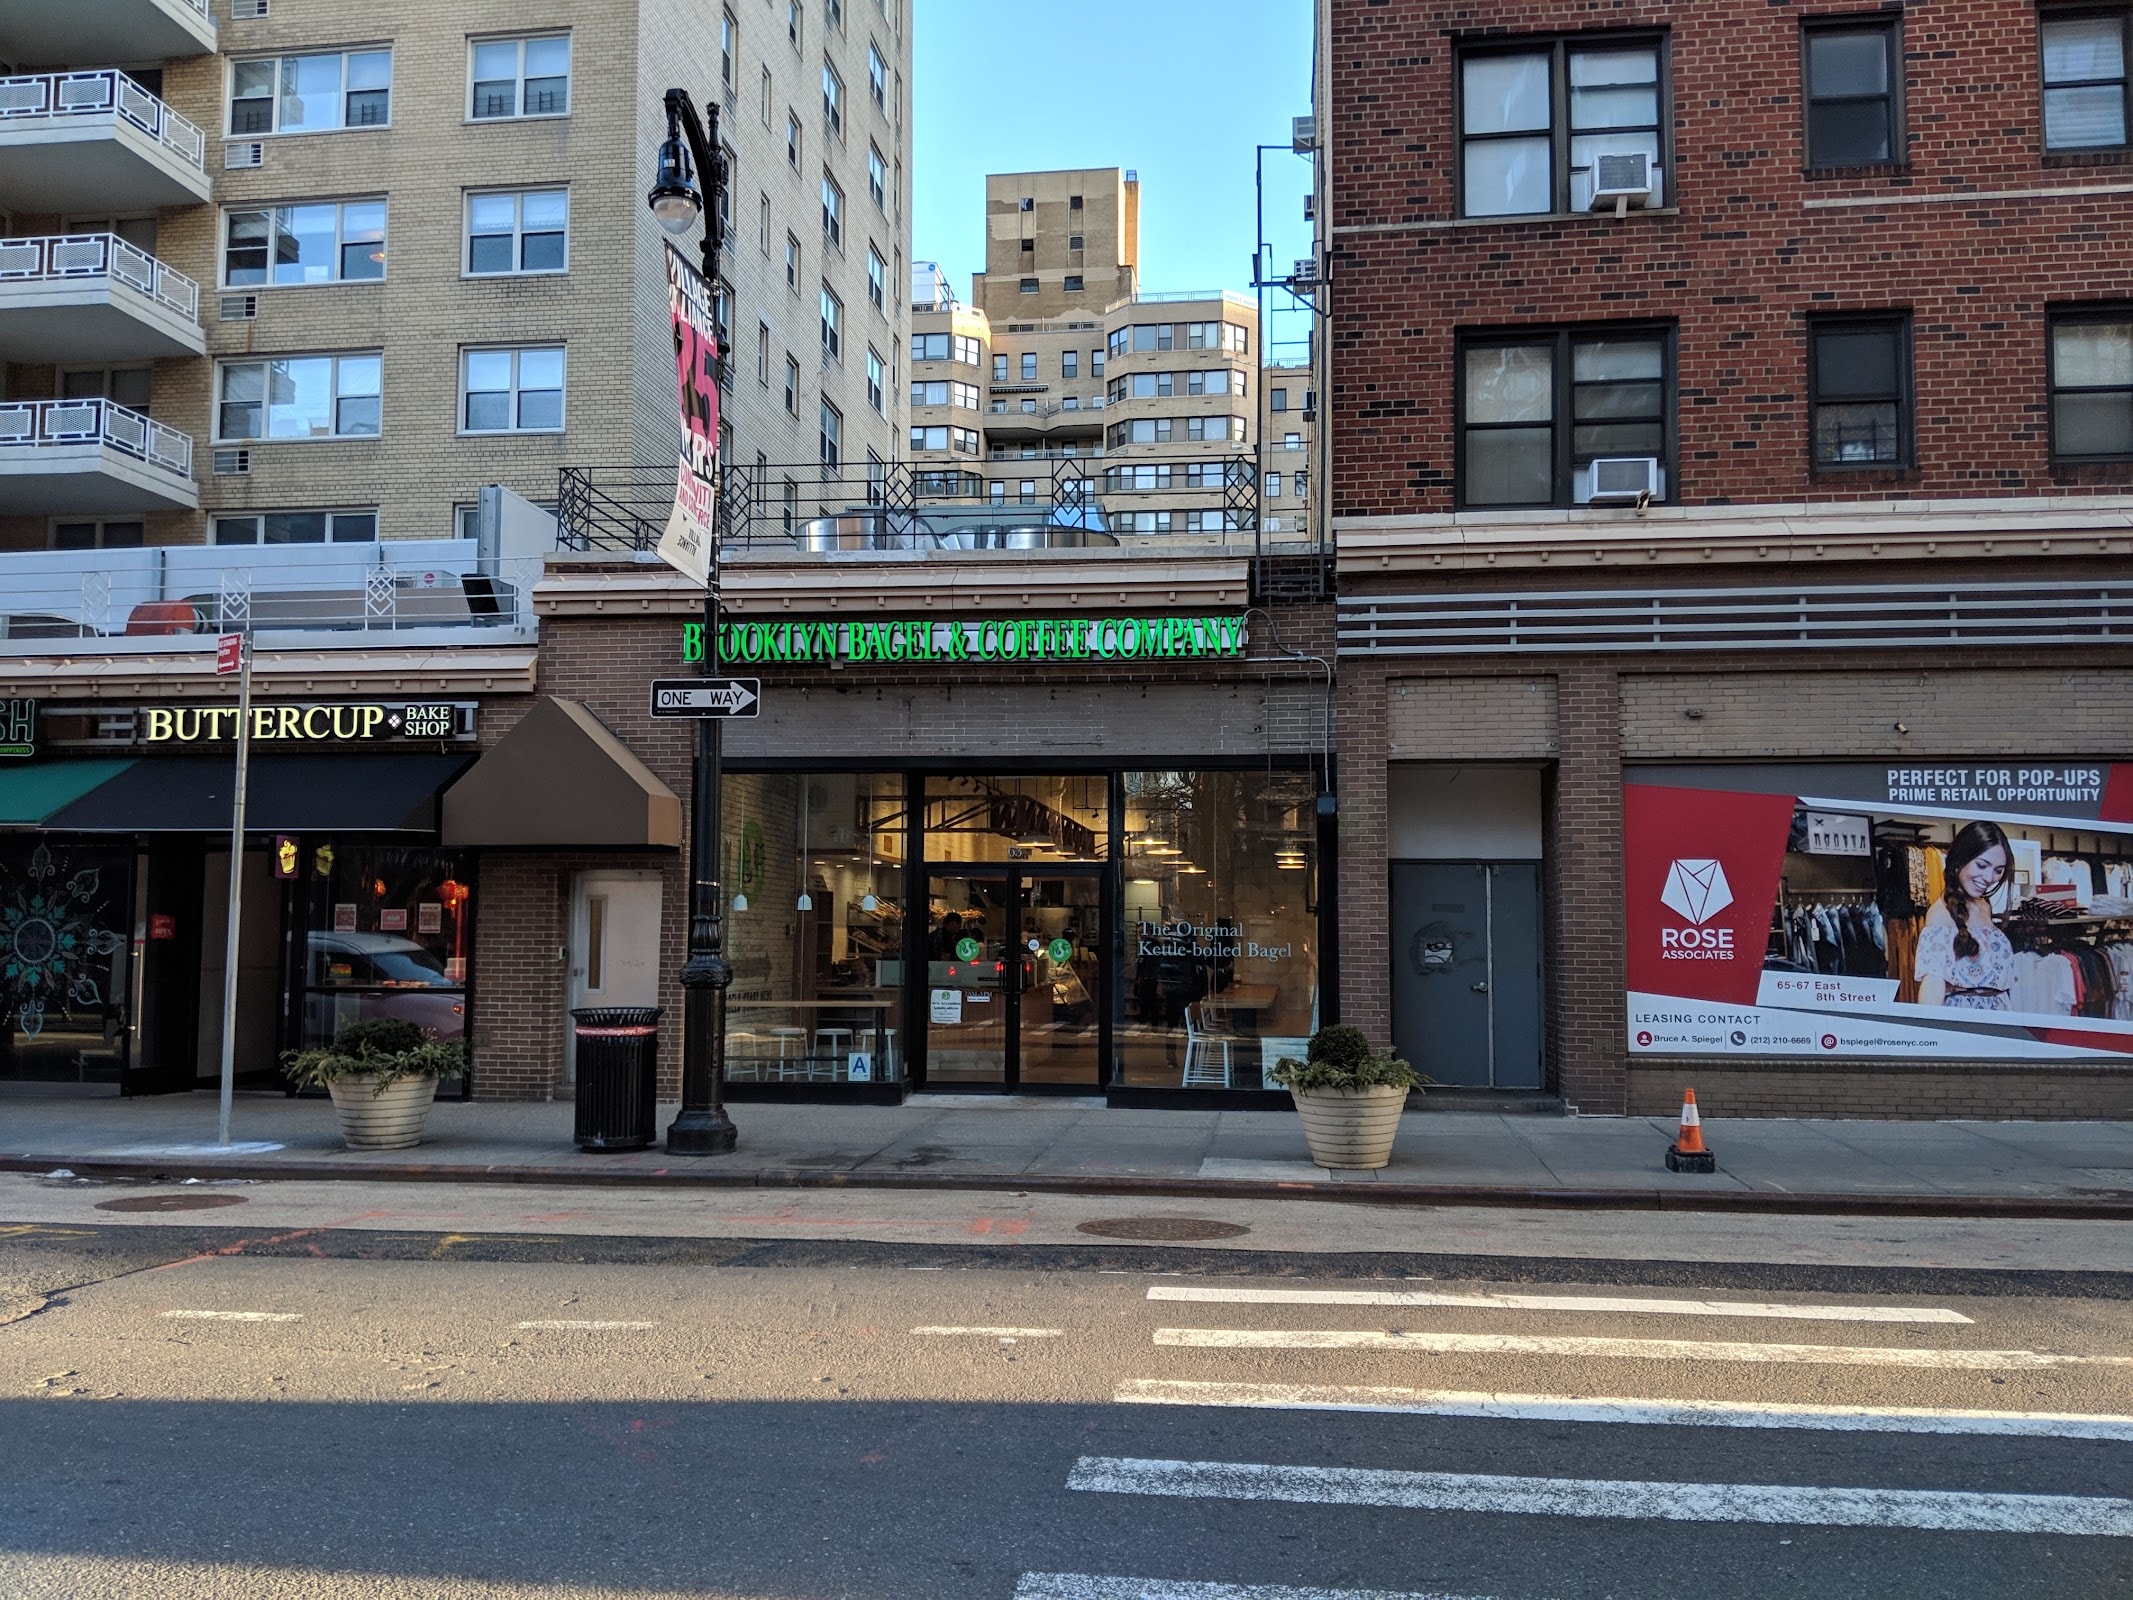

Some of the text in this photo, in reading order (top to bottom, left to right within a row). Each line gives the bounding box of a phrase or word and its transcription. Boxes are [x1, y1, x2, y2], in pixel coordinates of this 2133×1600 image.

[681, 461, 712, 511] COMNITY
[688, 494, 711, 530] COMRCE
[682, 616, 1244, 663] BOOKLYN BAGEL & COFFEE COMPANY
[661, 691, 744, 706] ONE WAY
[405, 707, 450, 720] BAKE
[147, 705, 385, 741] BUTTERCUP
[405, 721, 450, 737] SHOP
[1887, 769, 2101, 787] PERFECT FOR POP-UPS
[1888, 787, 2101, 802] PRIME RETAIL OPPORTUNITY
[1138, 921, 1244, 941] The Original
[1661, 928, 1735, 949] ROSE
[1137, 940, 1292, 962] Kettle-boiled Bagel
[1662, 950, 1735, 960] ASSOCIATES
[1777, 981, 1841, 990] 65-67 East
[1816, 992, 1877, 1002] 8th Street
[1635, 1013, 1761, 1025] LEASING CONTACT
[1654, 1035, 1723, 1045] Bruce A. Spiegel
[1750, 1036, 1771, 1046] (212)
[1840, 1038, 1938, 1048] bspiegel@rosenyc.com
[852, 1056, 867, 1074] A
